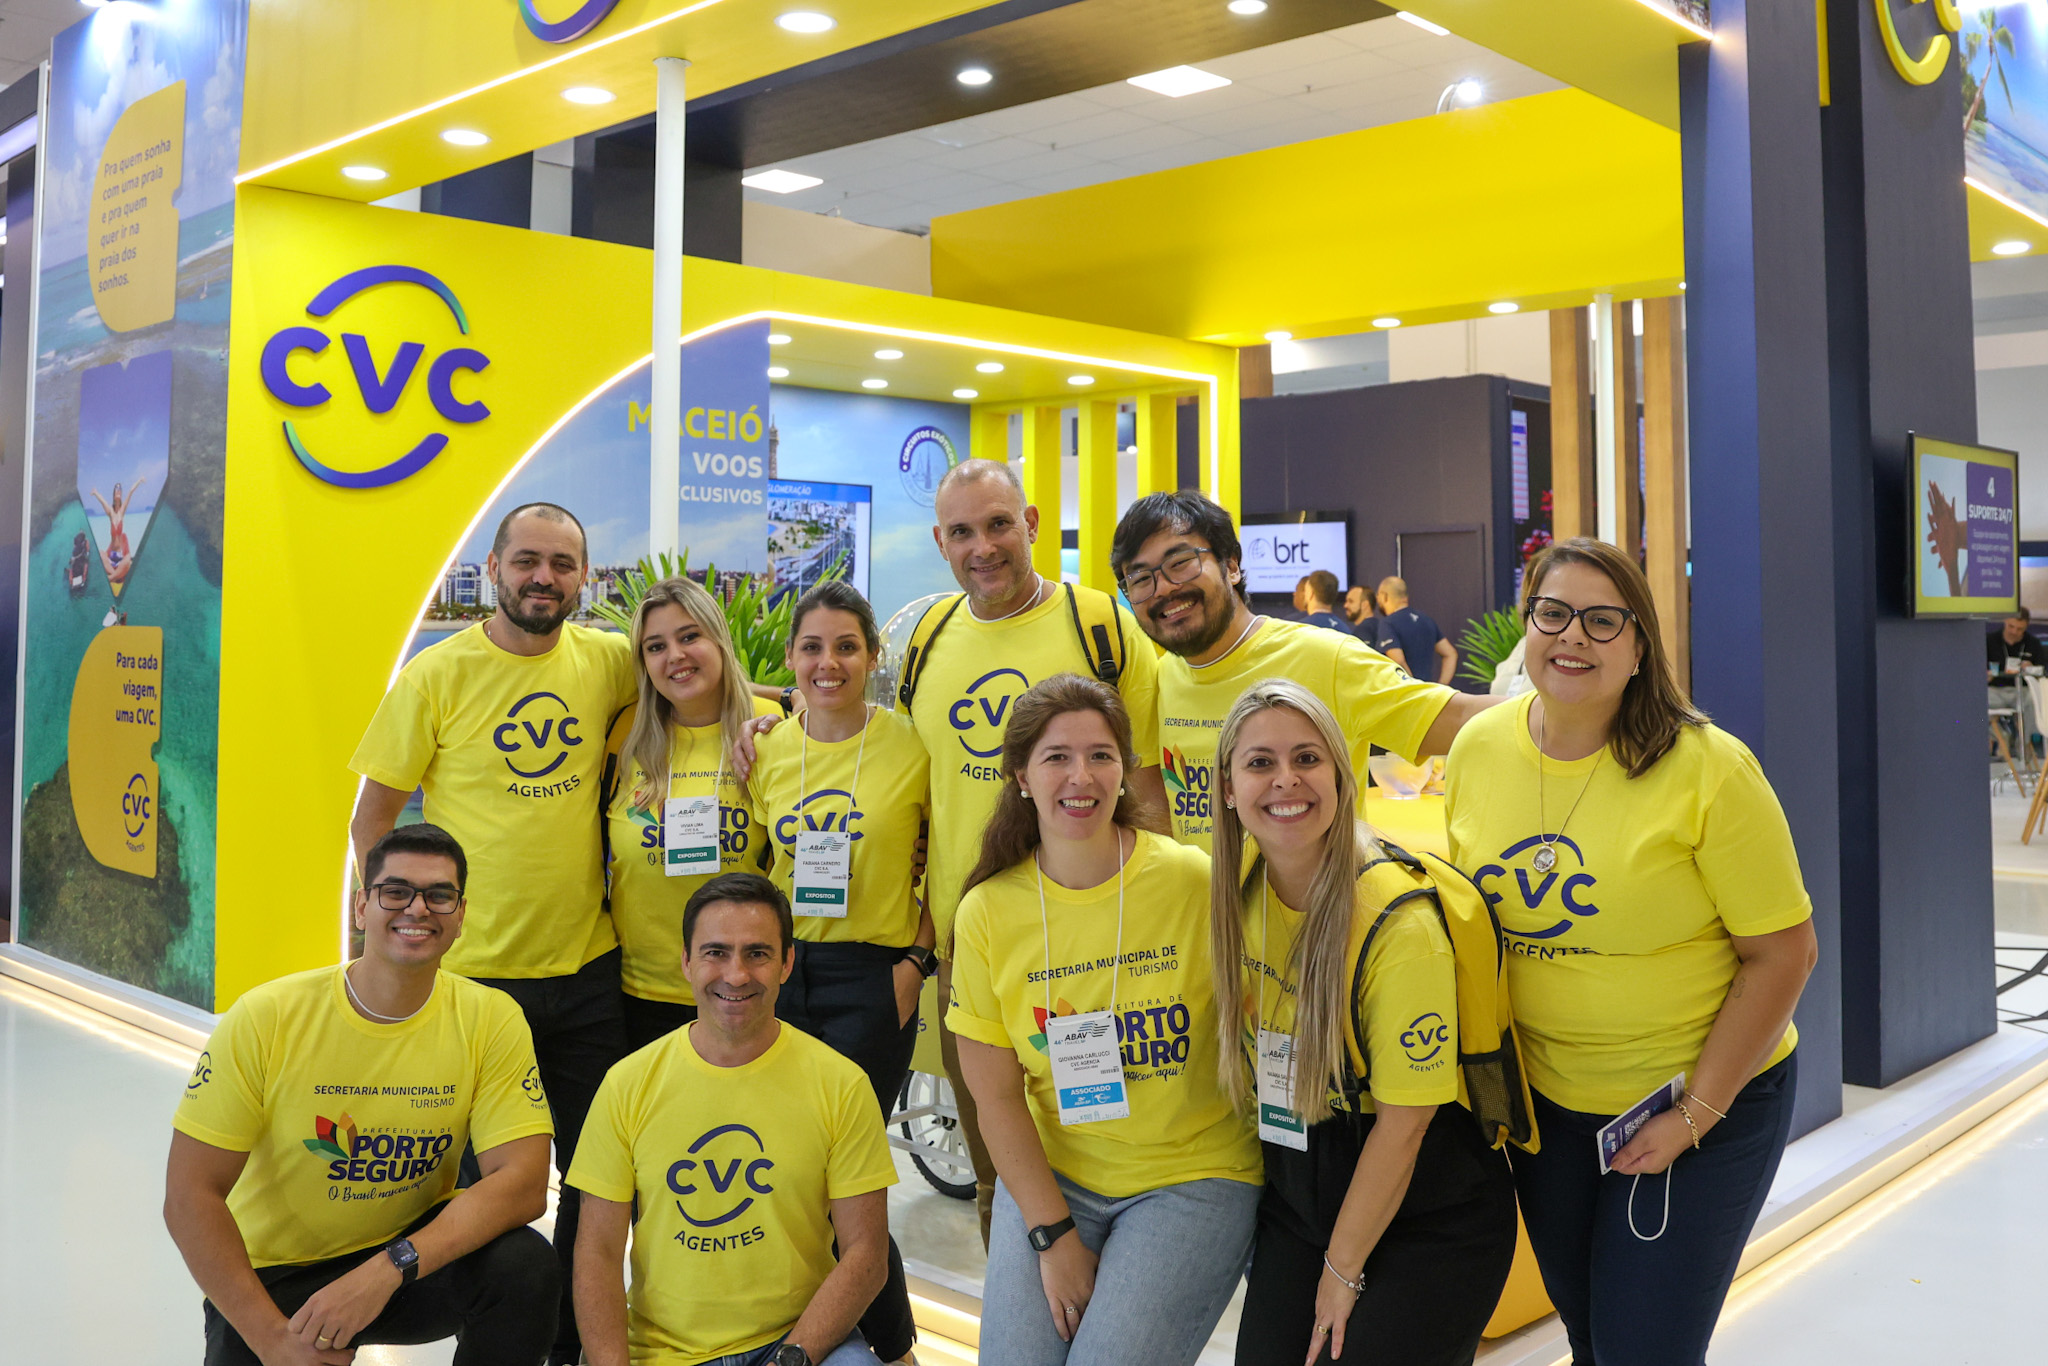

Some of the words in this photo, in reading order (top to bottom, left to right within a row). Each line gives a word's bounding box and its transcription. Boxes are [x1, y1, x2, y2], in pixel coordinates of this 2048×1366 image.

[104, 163, 118, 178] Pra
[120, 152, 142, 174] quem
[144, 139, 171, 161] sonha
[102, 184, 120, 201] com
[122, 176, 139, 194] uma
[141, 165, 163, 189] praia
[102, 212, 106, 224] e
[108, 206, 122, 224] pra
[124, 196, 147, 218] quem
[100, 230, 120, 249] quer
[121, 225, 128, 240] ir
[129, 222, 140, 237] na
[99, 251, 120, 273] praia
[122, 246, 136, 263] dos
[260, 326, 492, 424] CVC
[628, 401, 762, 443] MCEIÓ
[692, 452, 762, 478] VOOS
[678, 485, 762, 506] CLUSIVOS
[1987, 477, 1995, 498] 4
[1968, 504, 1998, 520] SUPORTE
[1274, 536, 1309, 564] brt
[116, 652, 135, 668] Para
[138, 654, 158, 670] cada
[123, 679, 157, 701] viagem,
[116, 709, 134, 723] uma
[136, 708, 156, 726] CVC.
[949, 694, 1025, 730] CV
[1165, 718, 1200, 728] SECRETARIA
[1201, 720, 1224, 728] MUNIC
[493, 717, 583, 752] CVC
[960, 763, 1004, 781] AGEN
[507, 775, 580, 798] AGENTES
[123, 793, 150, 819] CVC
[1175, 791, 1212, 818] SEG
[776, 811, 864, 844] CVC
[1473, 864, 1600, 916] CVC
[1503, 936, 1595, 960] AGENT
[1027, 962, 1094, 982] SECRETARIA
[1096, 948, 1159, 969] MUNICIPAL
[1162, 945, 1177, 957] DE
[1128, 960, 1178, 978] TURISMO
[1170, 994, 1183, 1003] DE
[1115, 1003, 1190, 1044] RTO
[1065, 1032, 1088, 1041] ABAV
[1400, 1025, 1449, 1048] CVC
[1119, 1035, 1190, 1067] URO
[1409, 1060, 1444, 1072] AGENTES
[314, 1085, 379, 1095] SECRETARIA
[381, 1086, 440, 1095] MUNICIPAL
[443, 1085, 456, 1094] DE
[1071, 1085, 1111, 1095] ASSOCIADO
[410, 1098, 454, 1108] TURISMO
[1269, 1112, 1296, 1124] EXPOSITOR
[352, 1134, 453, 1158] PORTO
[327, 1153, 444, 1182] SEGURO
[666, 1158, 774, 1195] CVC
[328, 1185, 340, 1200] O
[342, 1186, 377, 1202] Brasil
[379, 1186, 409, 1198] nasceu
[674, 1226, 765, 1252] AGENTES
